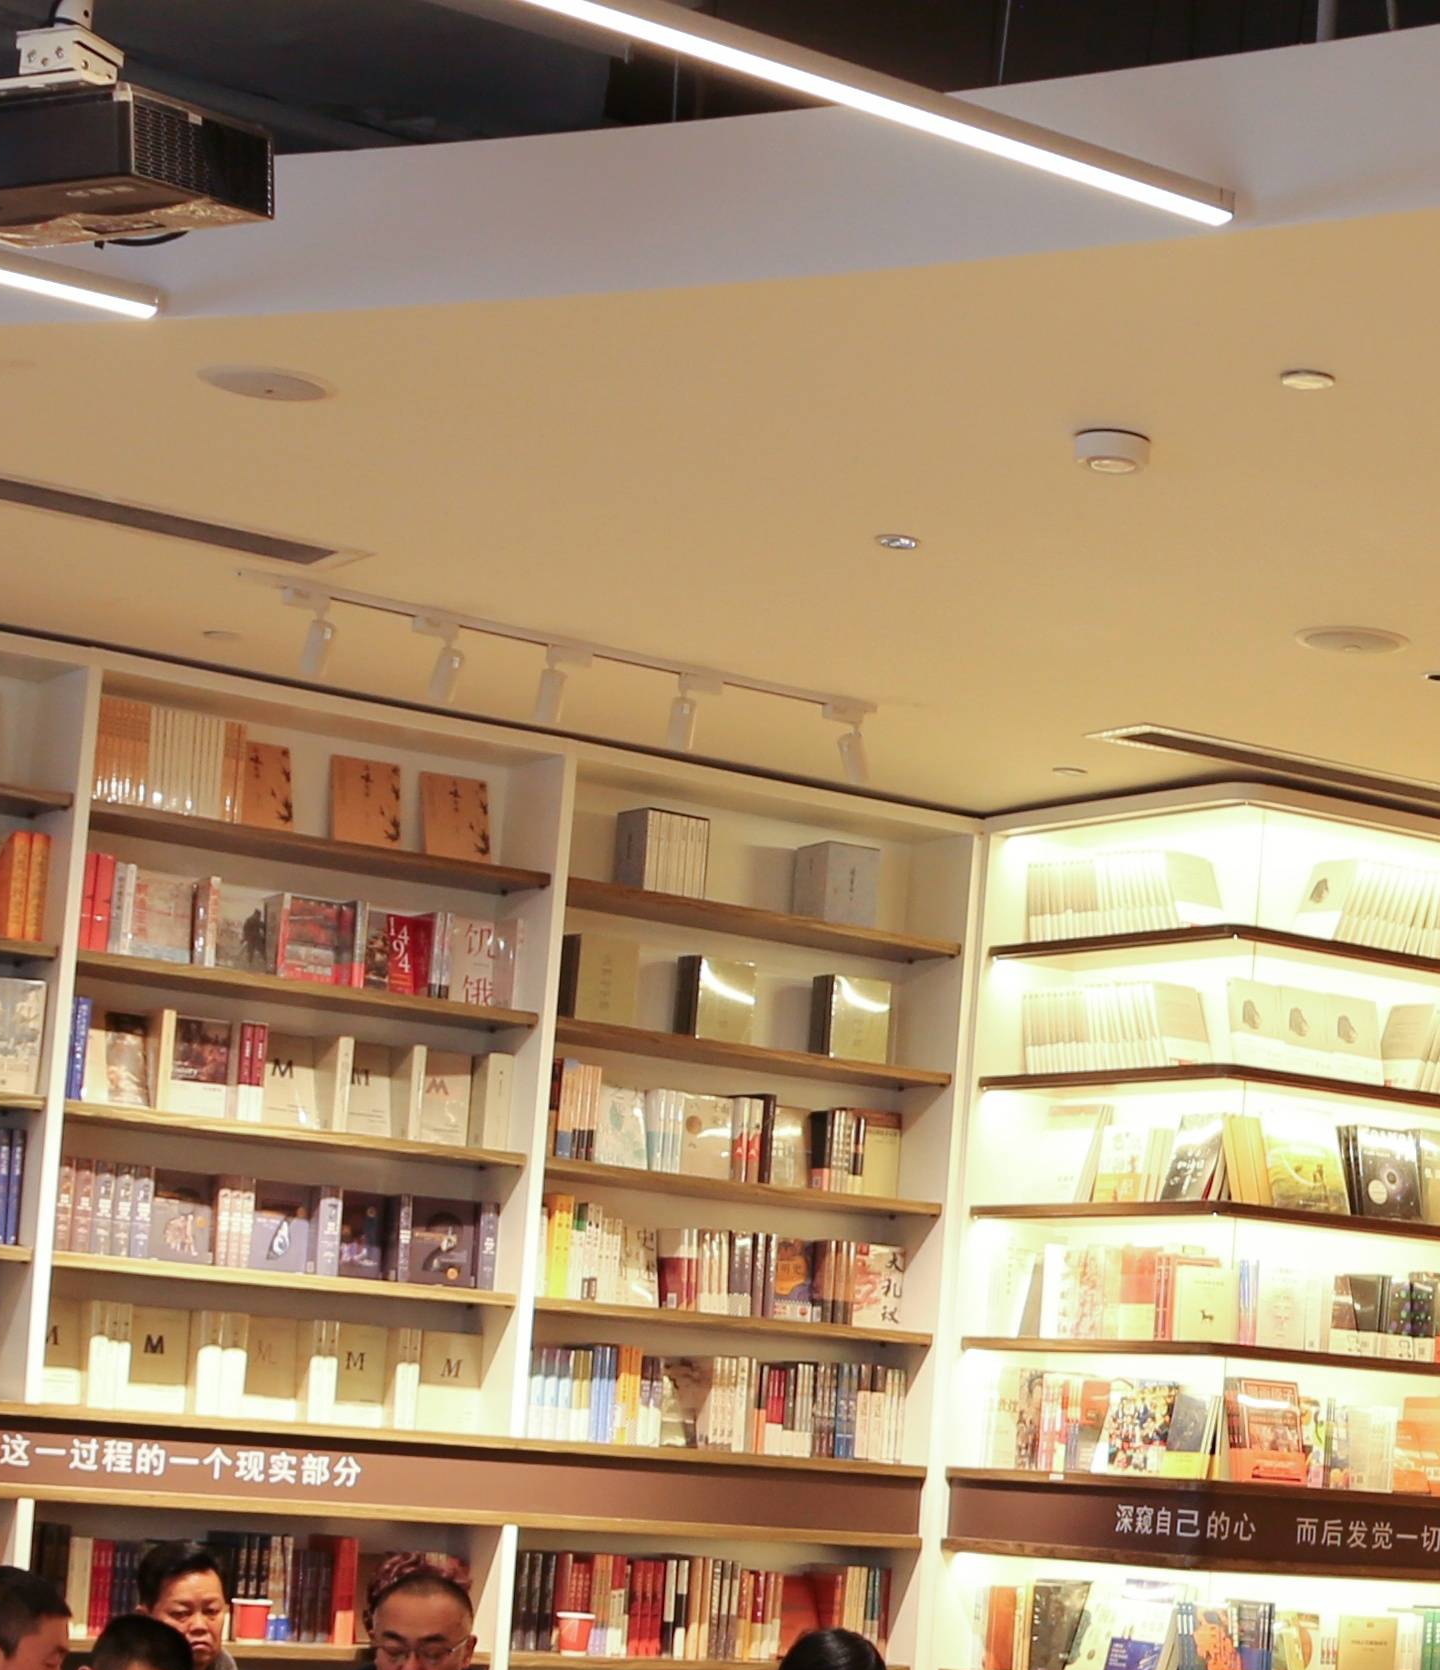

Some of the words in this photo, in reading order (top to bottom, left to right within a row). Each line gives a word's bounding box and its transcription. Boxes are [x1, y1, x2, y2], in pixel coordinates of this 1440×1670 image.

[1115, 1503, 1257, 1542] 深窥自己的心
